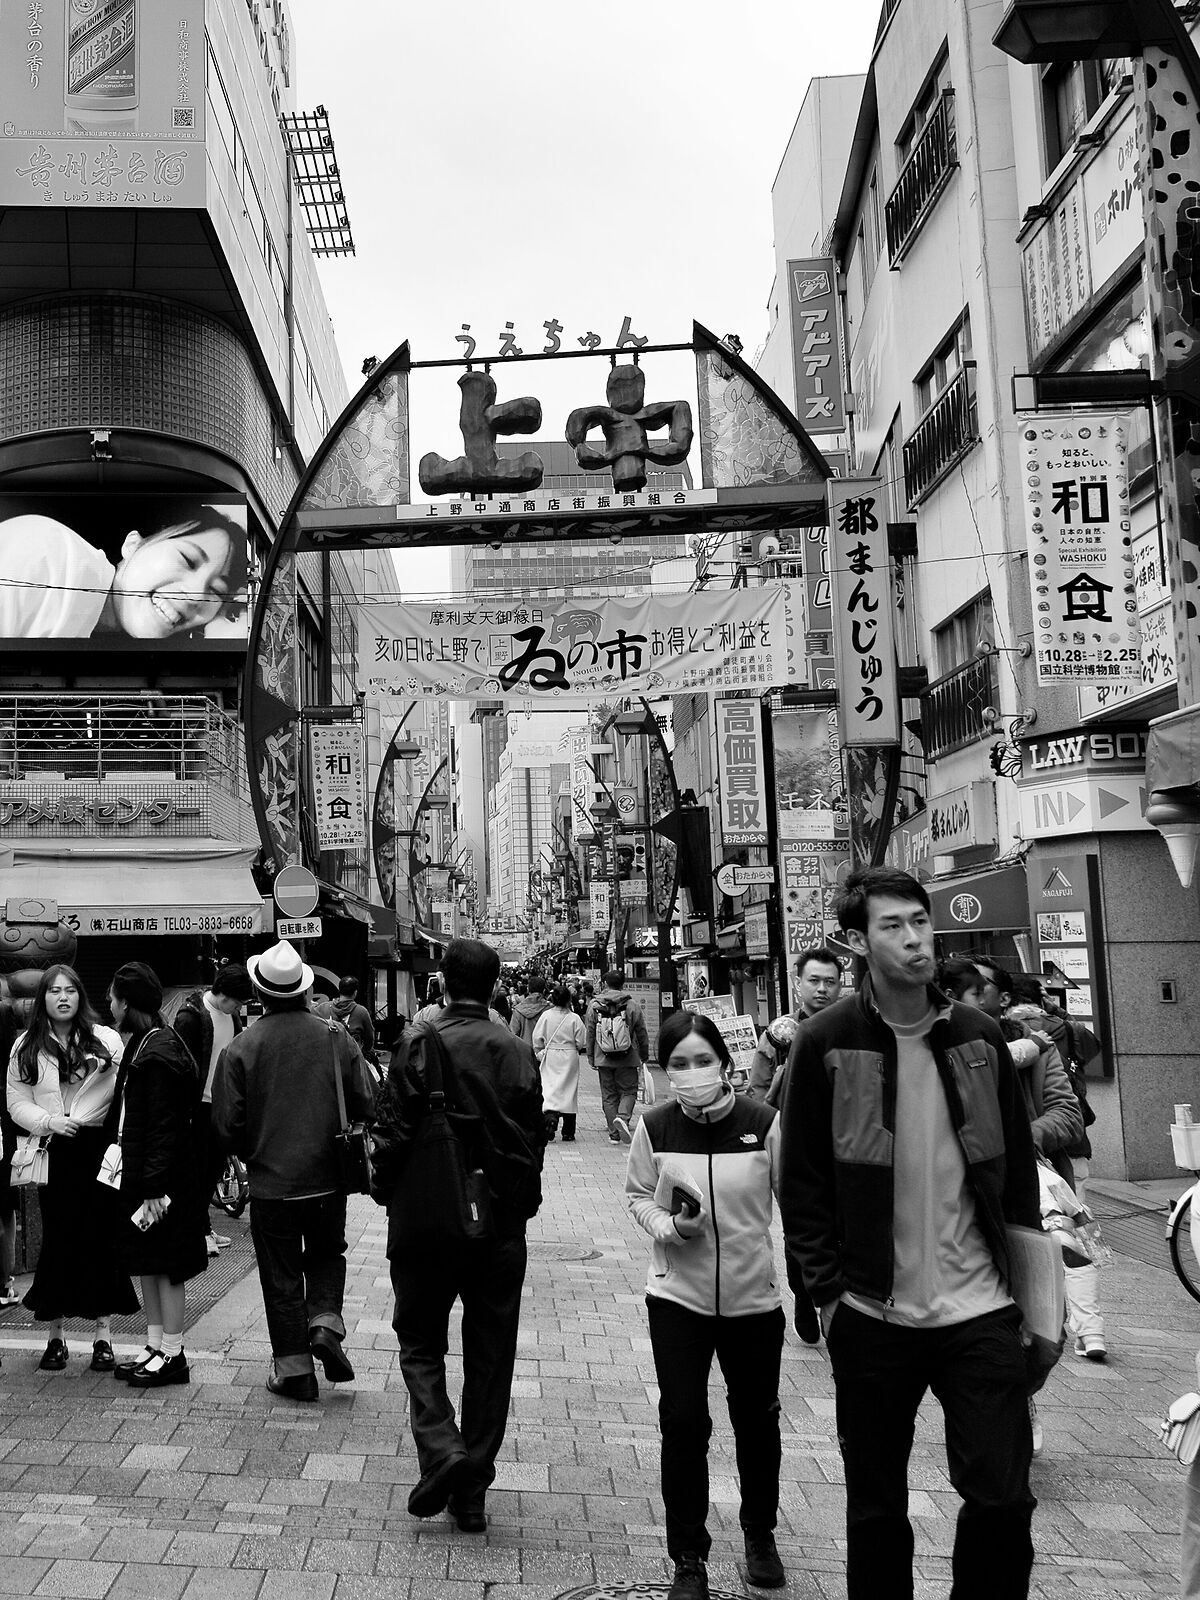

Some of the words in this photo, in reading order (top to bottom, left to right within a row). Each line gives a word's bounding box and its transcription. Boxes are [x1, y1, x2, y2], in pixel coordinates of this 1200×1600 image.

[43, 191, 54, 202] き
[63, 191, 90, 202] しゅう
[95, 191, 119, 202] まお
[123, 191, 147, 202] たい
[152, 192, 173, 202] しゅ
[800, 309, 834, 419] アドアーズ
[418, 364, 694, 496] 上中
[1062, 448, 1094, 458] 知ると、
[1046, 459, 1112, 469] もっとおいしい。
[426, 493, 686, 517] 上野中通商店街振興組合
[1051, 479, 1109, 524] 和
[1059, 553, 1107, 562] WASHOKU
[1057, 572, 1113, 622] 食
[429, 609, 544, 626] 摩利支天御縁日
[837, 496, 883, 722] 都まんじゅう
[652, 620, 771, 657] お得とご利益を
[375, 634, 486, 664] 亥の日は上野で
[498, 625, 648, 692] ゐの市
[1044, 649, 1082, 662] 10.28
[1103, 648, 1137, 662] 2.25
[573, 665, 604, 677] INOICHI
[1040, 664, 1120, 676] 国立科学博物館
[1030, 733, 1147, 769] LAWSO
[325, 754, 351, 775] 和
[722, 701, 762, 831] 高価買取
[326, 796, 353, 819] 食
[780, 788, 831, 811] モネ
[1033, 790, 1064, 828] IN
[1, 796, 201, 826] アメ横センター
[931, 800, 969, 842] 都まんじゅう
[724, 834, 766, 844] おたからや
[786, 857, 802, 873] 金
[735, 870, 774, 880] おたからや
[1042, 888, 1074, 898] NAGAFUJI
[164, 916, 253, 930] TEL03-3833-6668
[280, 922, 320, 936] 自転車を除く
[790, 923, 823, 936] ブランド
[790, 936, 822, 952] バッグ
